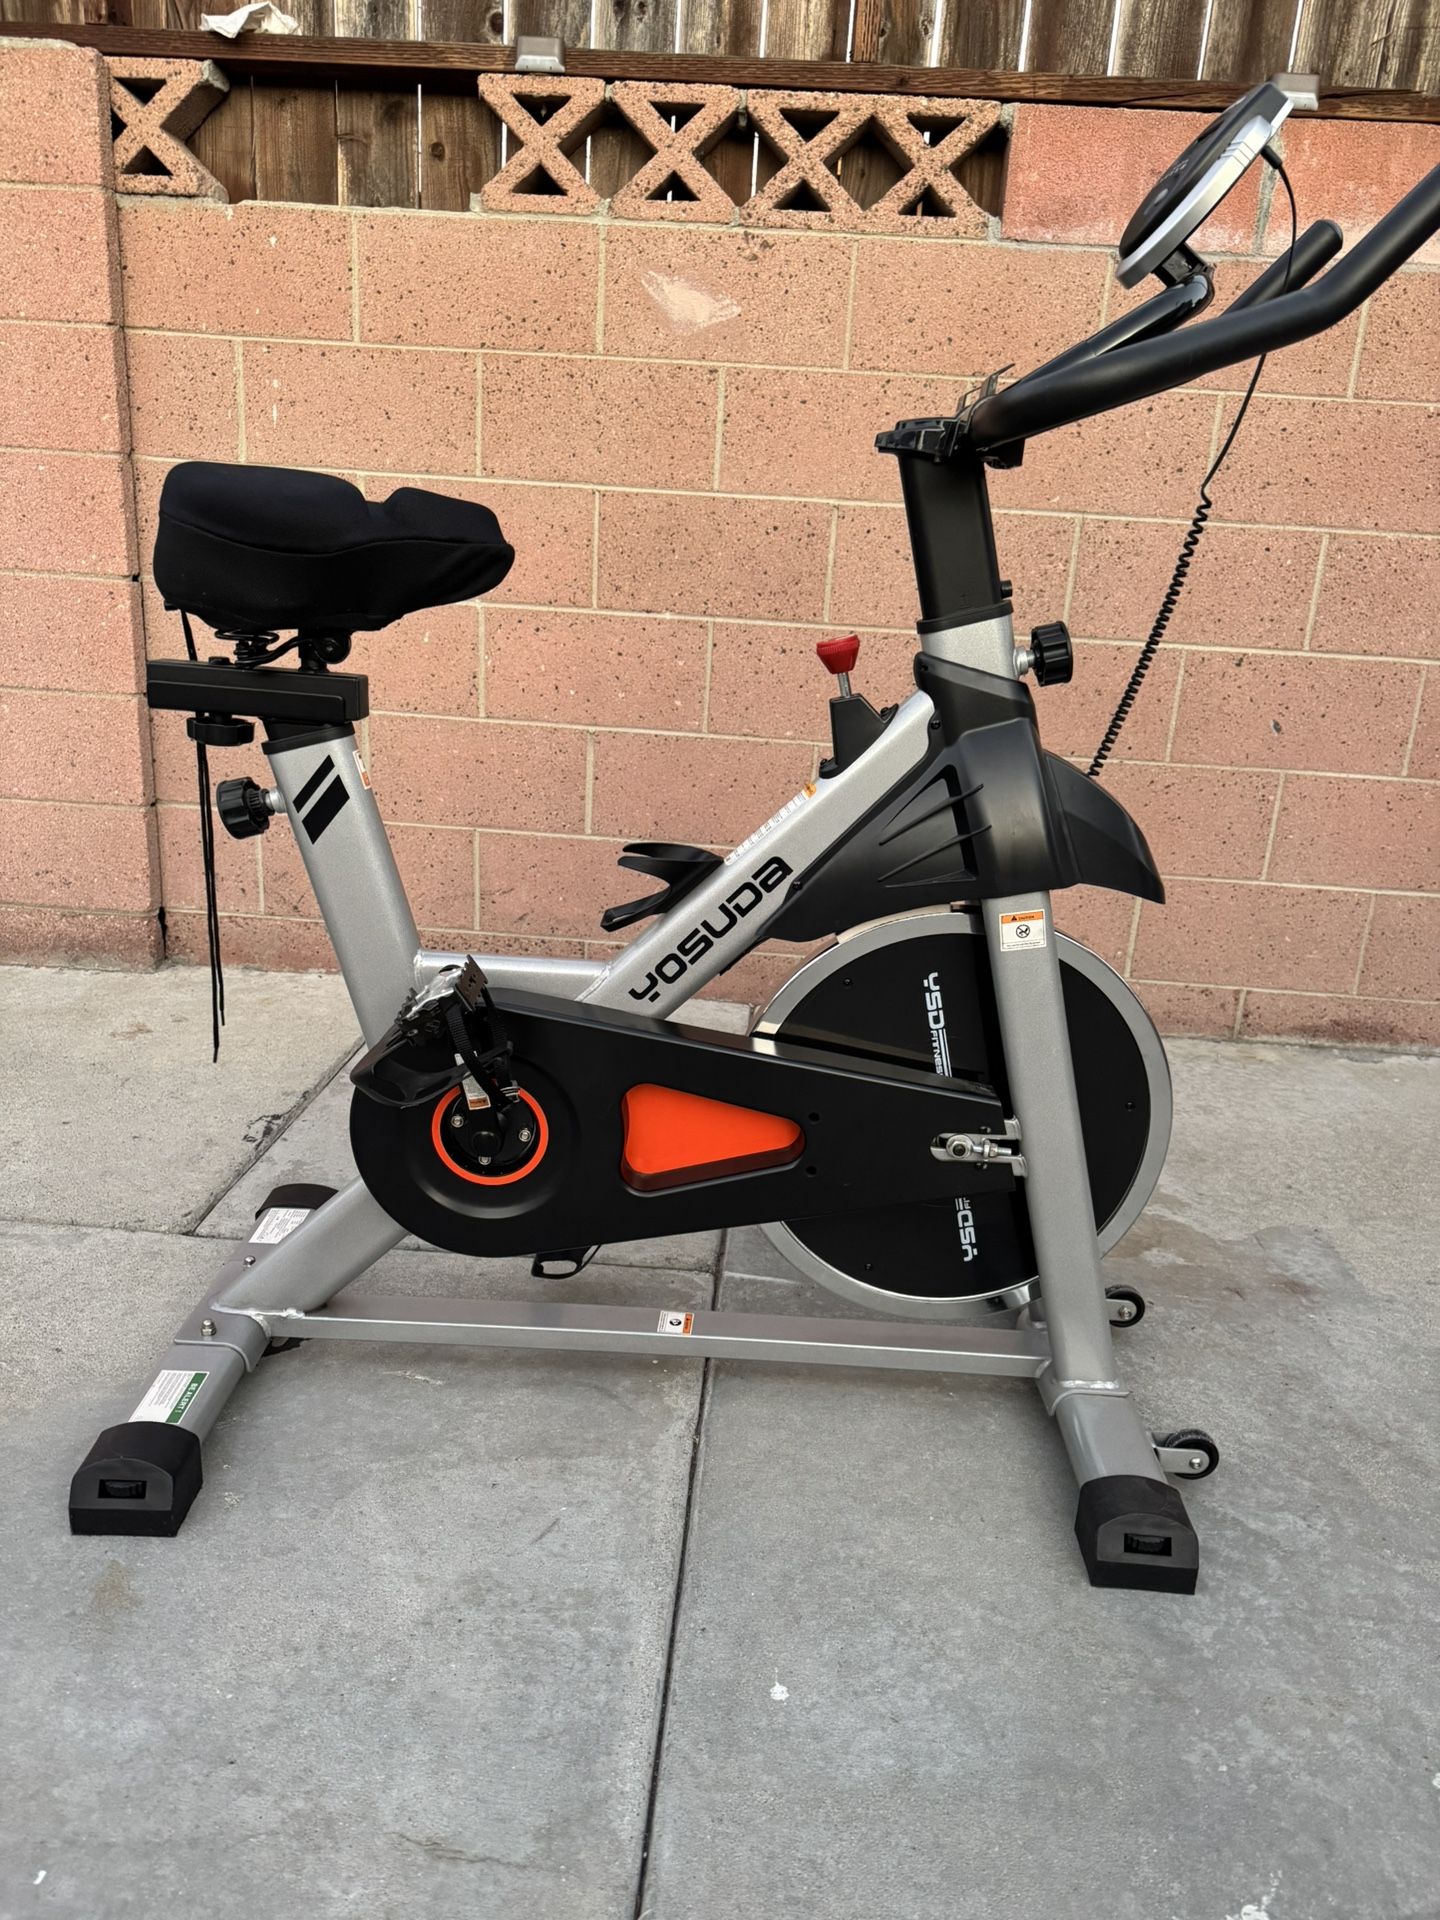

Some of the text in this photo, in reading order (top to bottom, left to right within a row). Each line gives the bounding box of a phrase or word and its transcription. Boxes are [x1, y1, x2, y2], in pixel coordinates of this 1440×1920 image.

[628, 856, 794, 1003] YOSUDA
[923, 972, 945, 1030] YSD
[930, 1029, 944, 1076] FITNES
[957, 1209, 978, 1262] YSD
